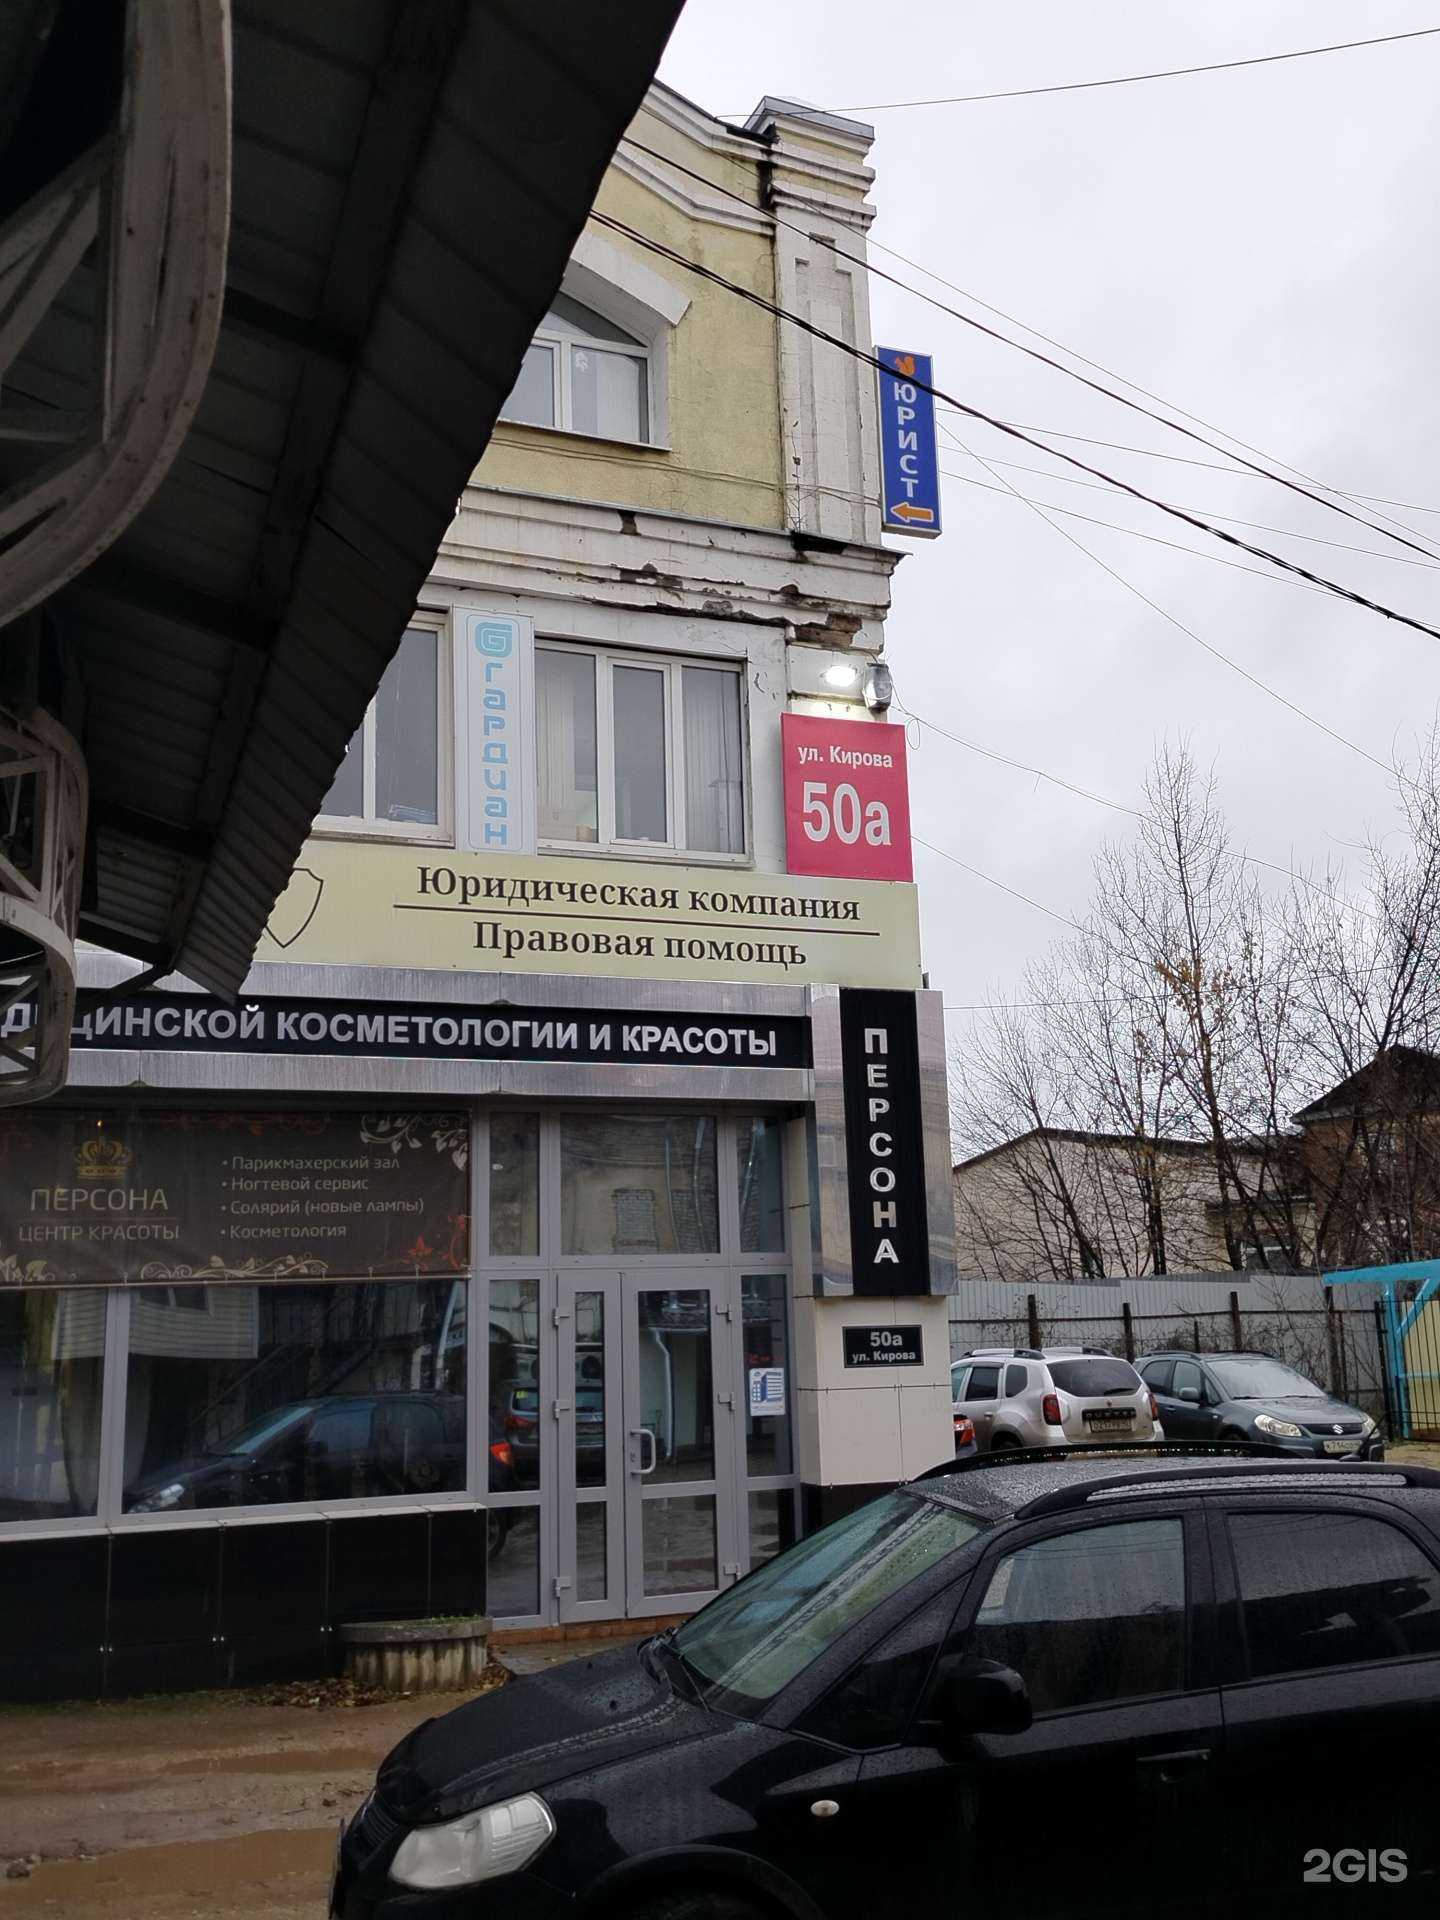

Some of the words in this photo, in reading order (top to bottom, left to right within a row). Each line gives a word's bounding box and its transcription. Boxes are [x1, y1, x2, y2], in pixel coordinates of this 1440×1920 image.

[894, 381, 919, 498] ЮРИСТ
[798, 746, 824, 765] ул.
[829, 746, 894, 769] Кирова
[802, 781, 892, 847] 50а
[416, 866, 680, 911] Юридическая
[687, 890, 861, 921] компания
[472, 921, 655, 960] Правовая
[663, 935, 807, 970] помощь
[276, 1010, 578, 1050] КОСМЕТОЛОГИИ
[589, 1024, 611, 1051] И
[622, 1025, 777, 1057] КРАСОТЫ
[864, 1027, 900, 1264] ПЕРСОНА
[231, 1156, 369, 1172] Парикмахерский
[374, 1159, 400, 1170] зал
[231, 1177, 311, 1191] Ногтевой
[314, 1179, 369, 1192] сервис
[30, 1187, 169, 1211] ПЕРСОНА
[230, 1201, 300, 1216] Солярий
[304, 1200, 362, 1216] (новые
[366, 1198, 425, 1214] лампы)
[18, 1226, 84, 1242] ЦЕНТР
[88, 1225, 181, 1241] КРАСОТЫ
[229, 1224, 347, 1239] Косметология
[870, 1331, 903, 1347] 50а
[852, 1353, 870, 1363] ул.
[873, 1351, 916, 1362] Кирова
